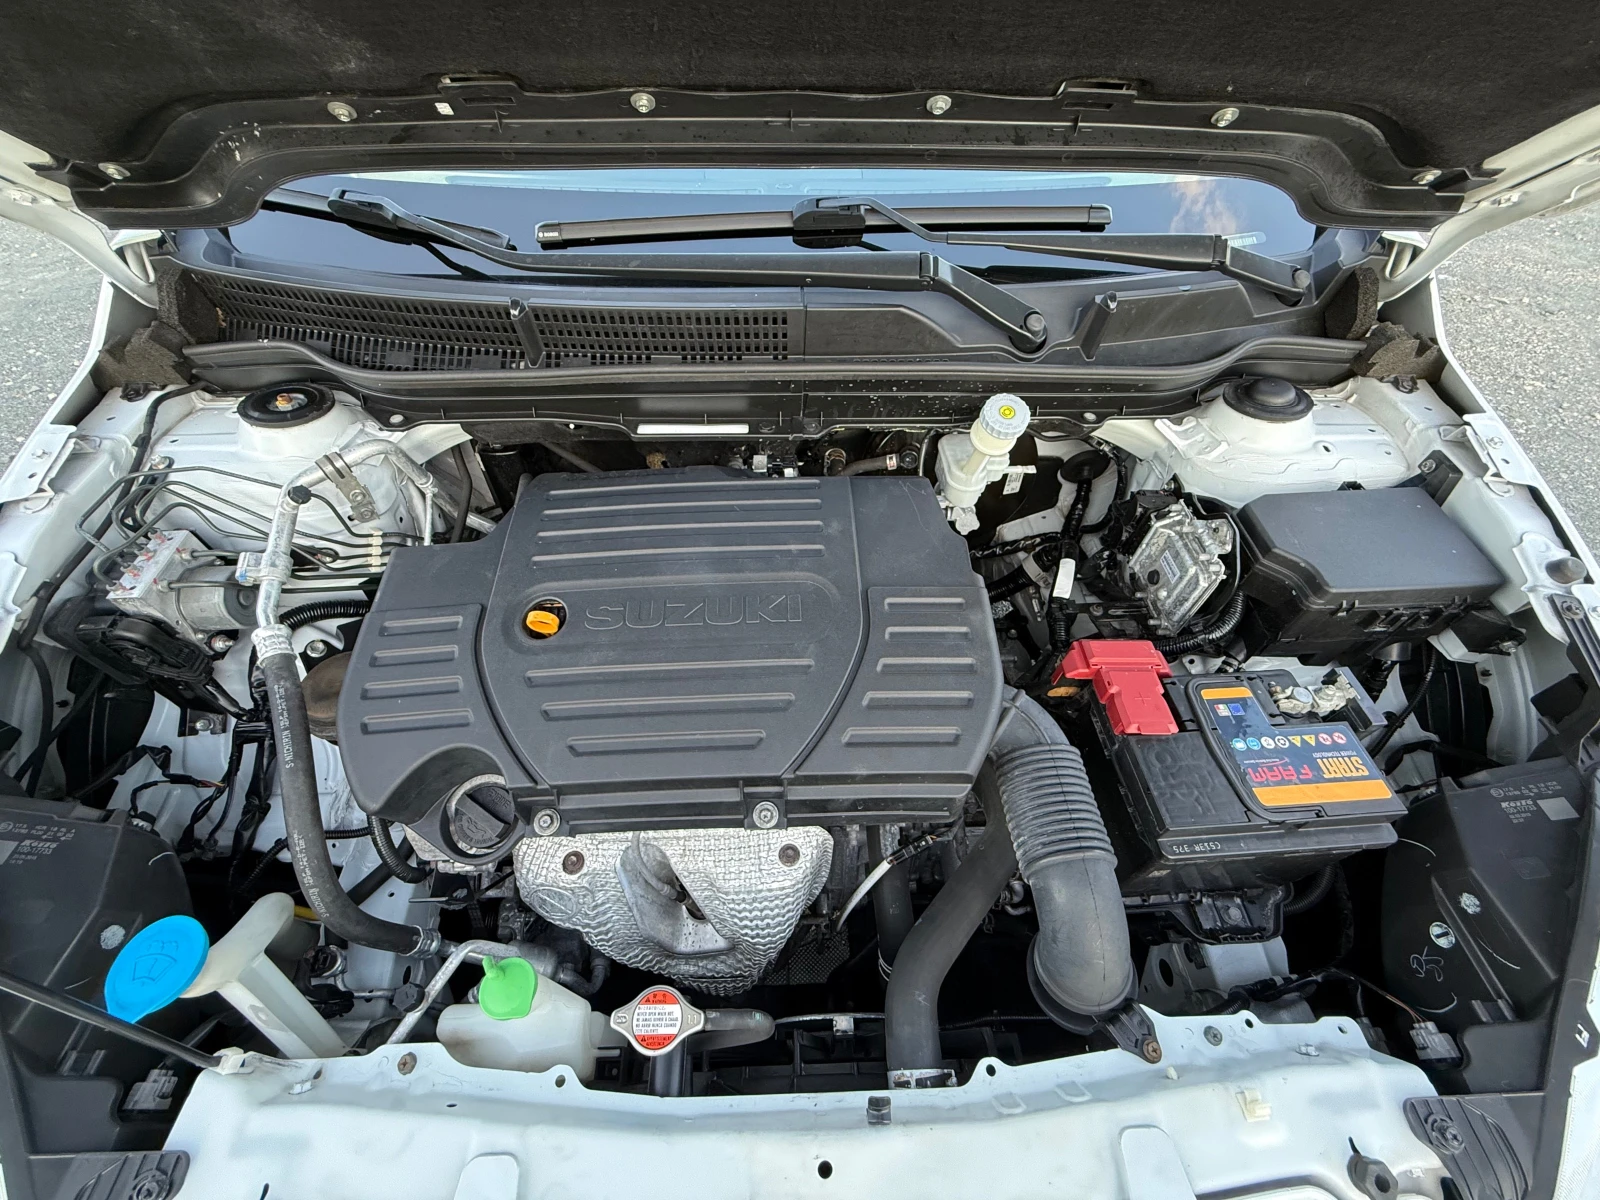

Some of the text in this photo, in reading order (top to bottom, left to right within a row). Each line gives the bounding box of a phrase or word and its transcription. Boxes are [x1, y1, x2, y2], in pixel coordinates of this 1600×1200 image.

[584, 594, 802, 631] SUZUKI
[1247, 764, 1313, 782] FAAM
[1316, 756, 1369, 778] START
[1173, 842, 1221, 853] CS13R 375
[687, 1014, 696, 1024] 1.1
